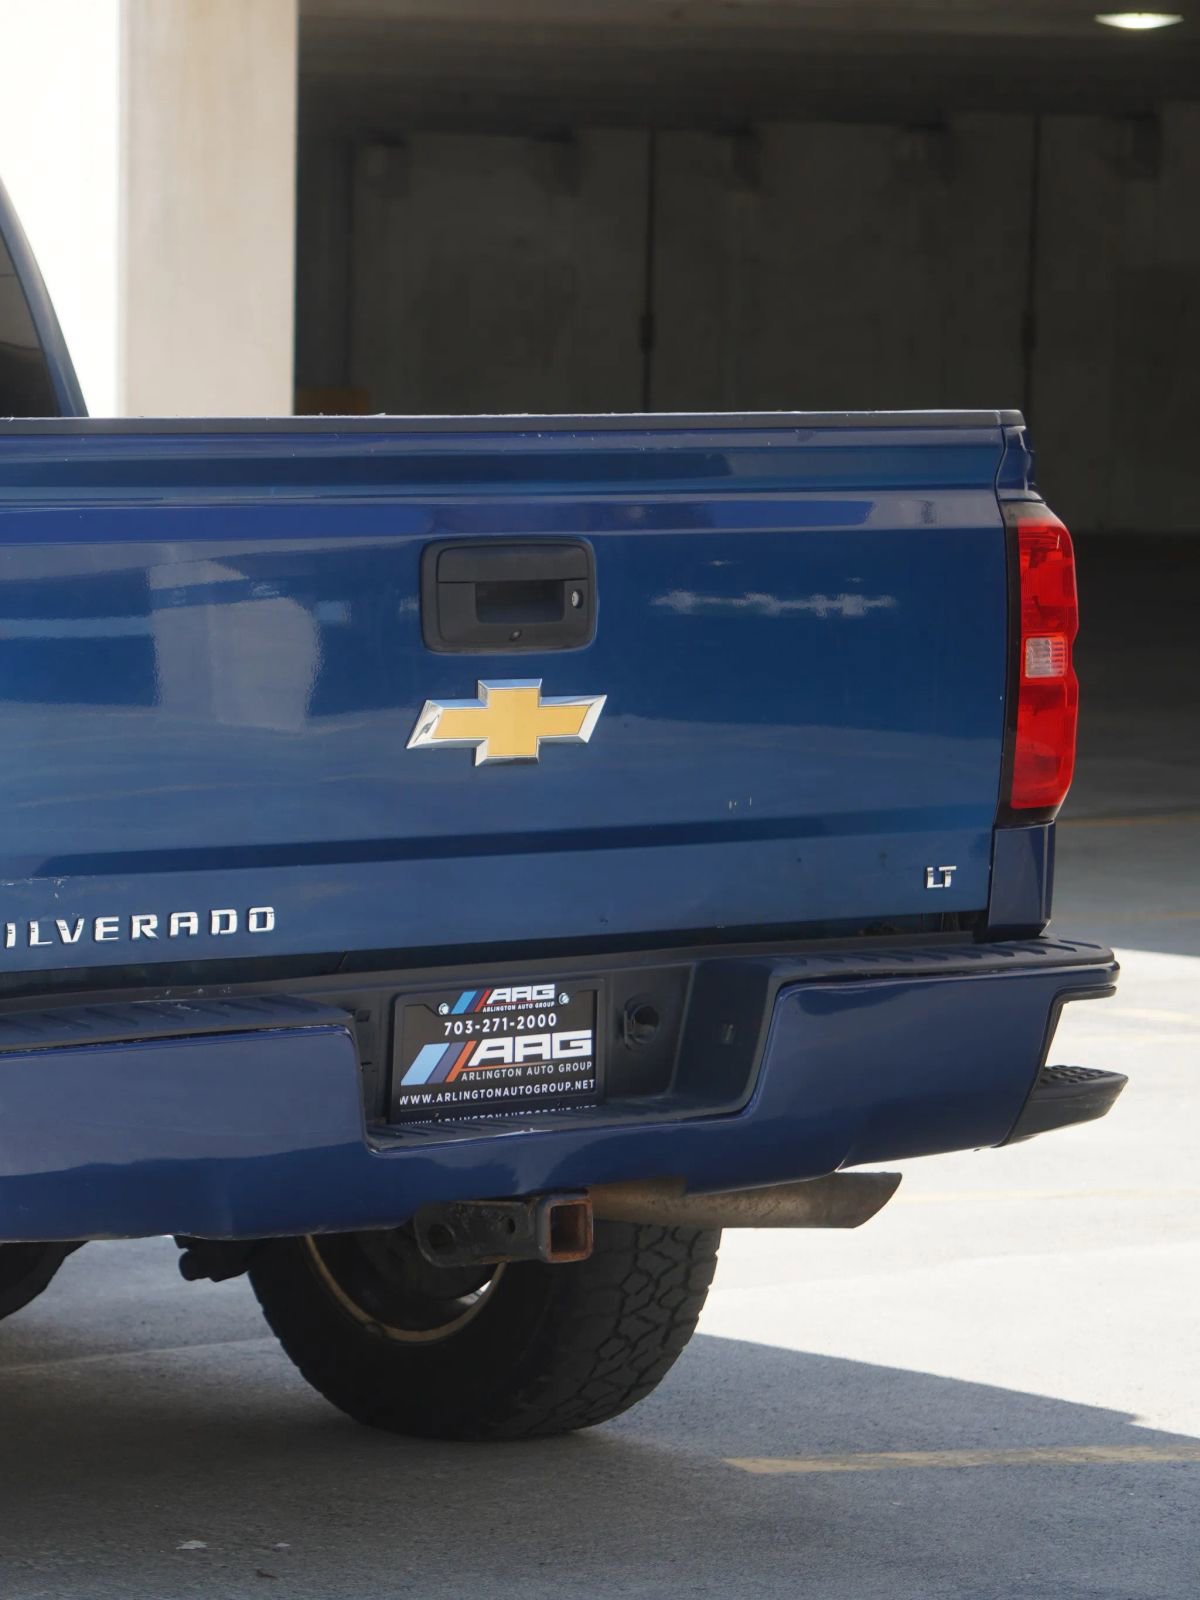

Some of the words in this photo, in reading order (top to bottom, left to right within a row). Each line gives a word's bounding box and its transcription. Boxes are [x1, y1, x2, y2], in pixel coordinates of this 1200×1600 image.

[926, 865, 957, 889] LT
[487, 984, 556, 1004] AAG
[482, 1004, 516, 1013] ARLINGTON
[518, 1002, 533, 1010] AUTO
[535, 1001, 555, 1009] GROUP
[444, 1013, 557, 1036] 703-271-2000
[468, 1030, 593, 1067] AAG
[461, 1068, 522, 1081] ARLINGTON
[526, 1064, 554, 1076] AUTO
[558, 1061, 593, 1073] GROUP
[399, 1079, 596, 1106] WWW.ARLINGTONAUTOGROUP.NET
